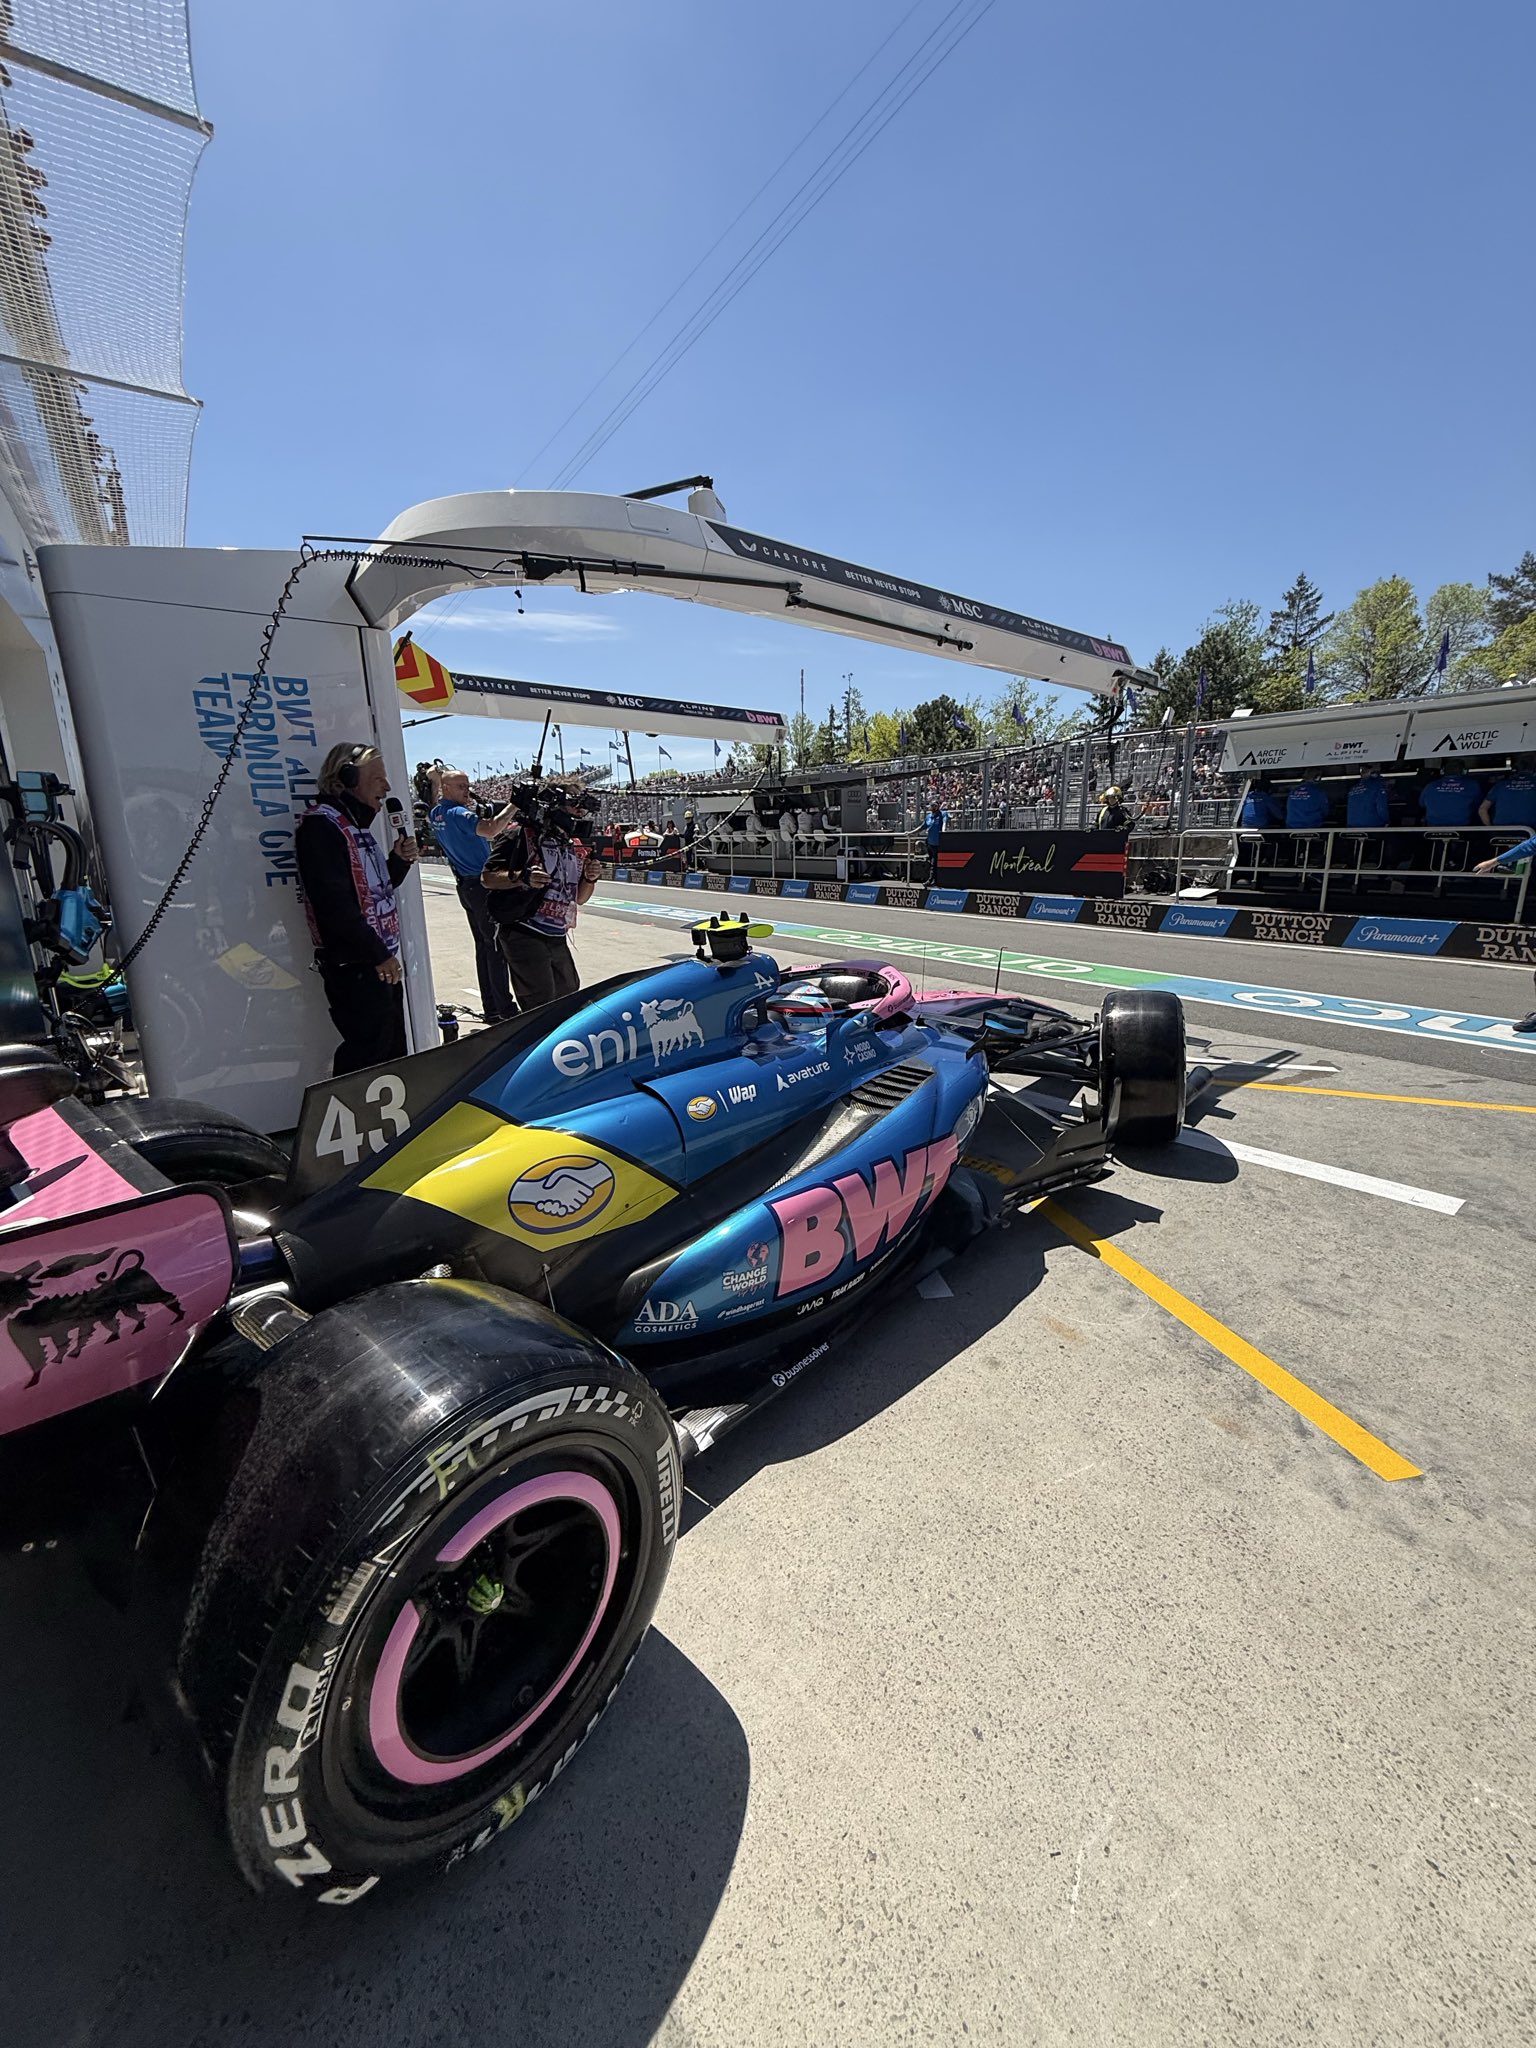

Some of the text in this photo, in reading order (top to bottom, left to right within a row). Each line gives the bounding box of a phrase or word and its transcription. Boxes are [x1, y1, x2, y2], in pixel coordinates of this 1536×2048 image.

[763, 546, 827, 572] CASTORE
[845, 570, 921, 599] BETTER NEVER STOPS
[950, 599, 983, 619] MSC
[1021, 619, 1060, 635] ALPINE
[1103, 645, 1126, 662] BWT
[468, 680, 516, 691] CASTORE
[530, 687, 551, 695] BETTER
[617, 696, 644, 708] MSC
[679, 704, 715, 712] ALPINE
[192, 672, 242, 760] TEAM
[272, 675, 318, 747] BWT
[756, 714, 779, 725] BWT
[1457, 730, 1500, 742] ARCTIC
[1342, 742, 1363, 750] BWT
[1461, 740, 1493, 751] WOLF
[1256, 749, 1287, 758] ARCTIC
[1260, 757, 1282, 765] WOLF
[232, 672, 301, 887] FORMULA ONE
[637, 849, 656, 857] Formula
[755, 879, 778, 888] DUTTON
[757, 887, 777, 895] RANCH
[814, 883, 841, 893] DUTTON
[816, 891, 840, 900] RANCH
[886, 888, 919, 899] DUTTON
[976, 894, 1020, 906] DUTTON
[888, 897, 917, 908] RANCH
[979, 904, 1017, 916] RANCH
[1033, 902, 1076, 915] Paramount+
[1094, 902, 1152, 917] DUTTON
[1097, 913, 1148, 928] RANCH
[1169, 912, 1226, 928] Paramount+
[1251, 912, 1332, 930] DUTTON
[1254, 926, 1325, 944] RANCH
[1357, 925, 1439, 945] Paramount+
[1476, 927, 1536, 946] DUT
[551, 1011, 638, 1077] eni
[854, 1040, 871, 1052] MODO
[857, 1049, 877, 1063] CASINO
[787, 1060, 831, 1085] avature
[728, 1083, 757, 1105] Wap
[315, 1074, 411, 1166] 43
[771, 1135, 959, 1297] BWT
[722, 1265, 768, 1286] CHANGE
[732, 1275, 767, 1292] WORLD
[634, 1299, 699, 1322] ADA
[634, 1322, 697, 1333] COSMETICS
[781, 1342, 830, 1380] businessolver
[656, 1433, 680, 1546] PIRELLI
[262, 1663, 332, 1887] ZERO
